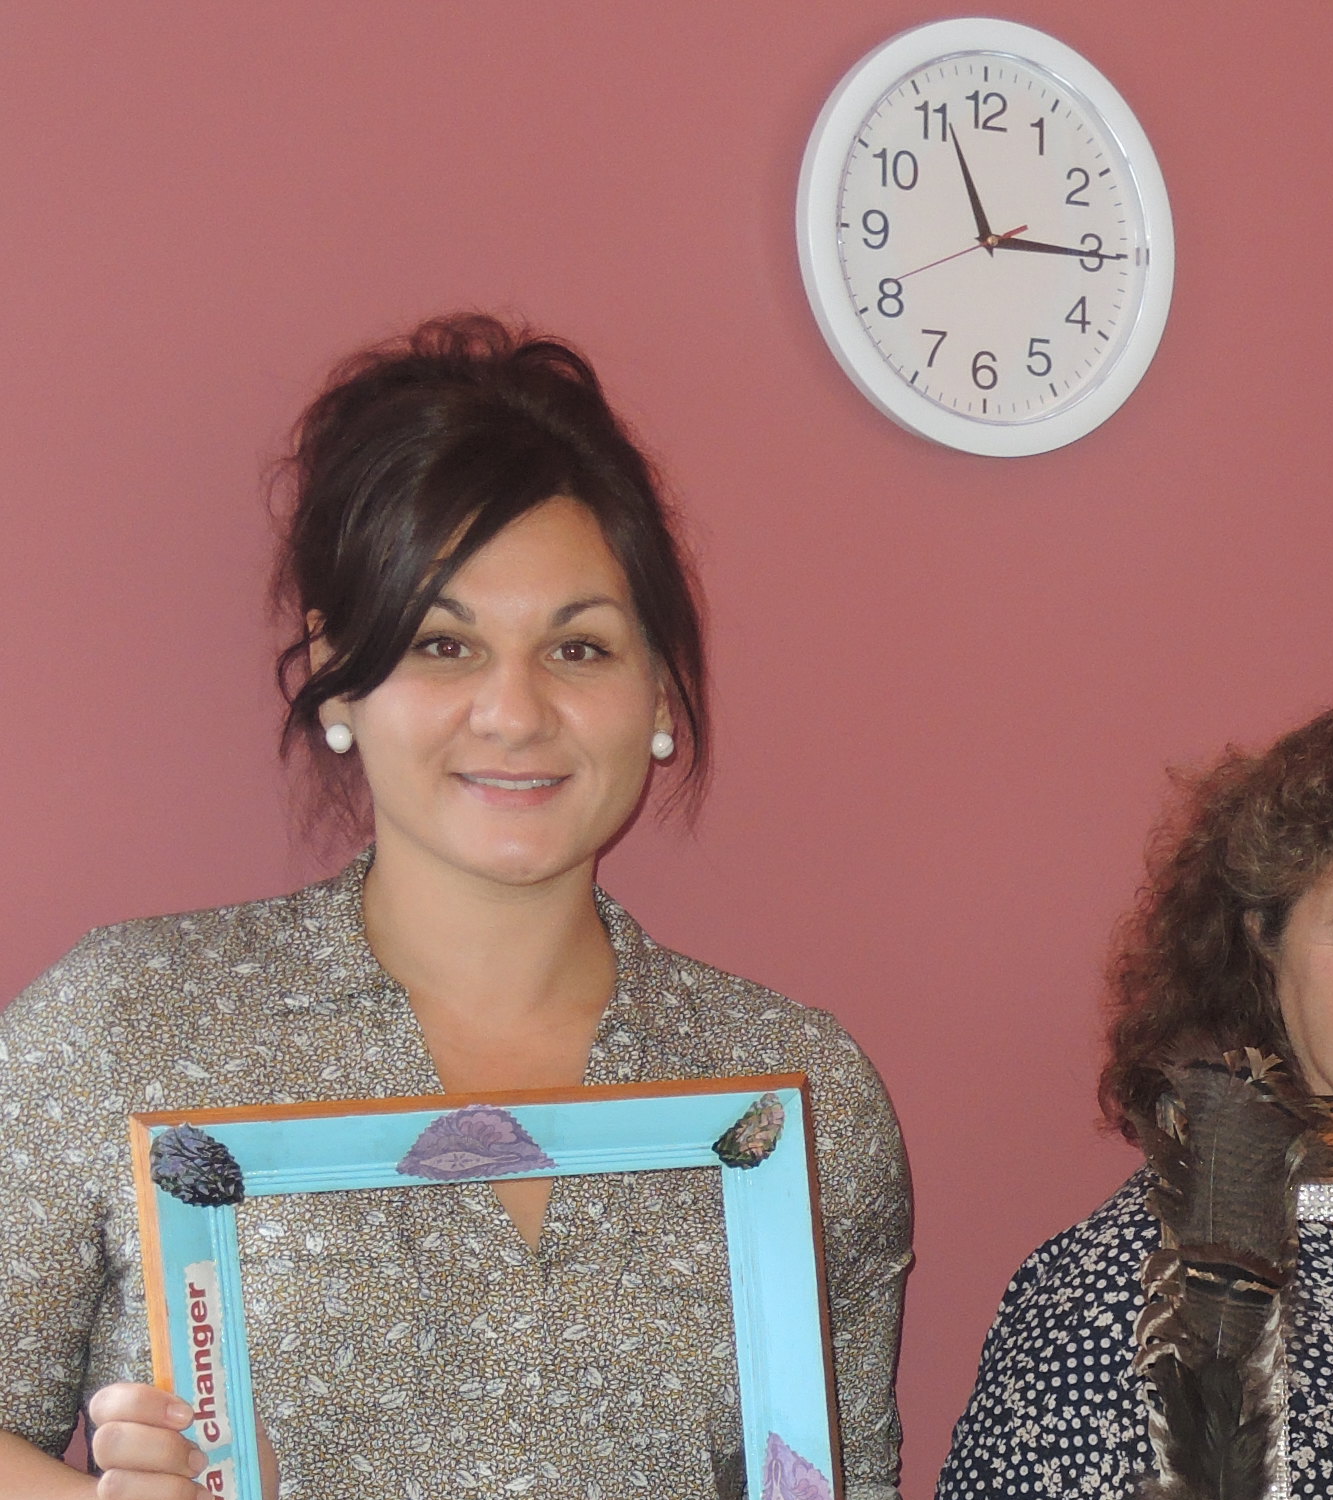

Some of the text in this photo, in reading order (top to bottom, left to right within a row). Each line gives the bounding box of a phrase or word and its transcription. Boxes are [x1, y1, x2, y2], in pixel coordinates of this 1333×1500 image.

[915, 101, 948, 142] 11
[965, 90, 1007, 132] 12
[1030, 117, 1045, 156] 1
[872, 147, 919, 190] 10
[1065, 168, 1090, 207] 2
[862, 209, 889, 250] 9
[1079, 233, 1104, 272] 3
[877, 278, 904, 318] 8
[1065, 296, 1091, 334] 4
[921, 329, 948, 368] 7
[1026, 338, 1052, 376] 5
[971, 351, 998, 390] 6
[189, 1282, 220, 1444] changer
